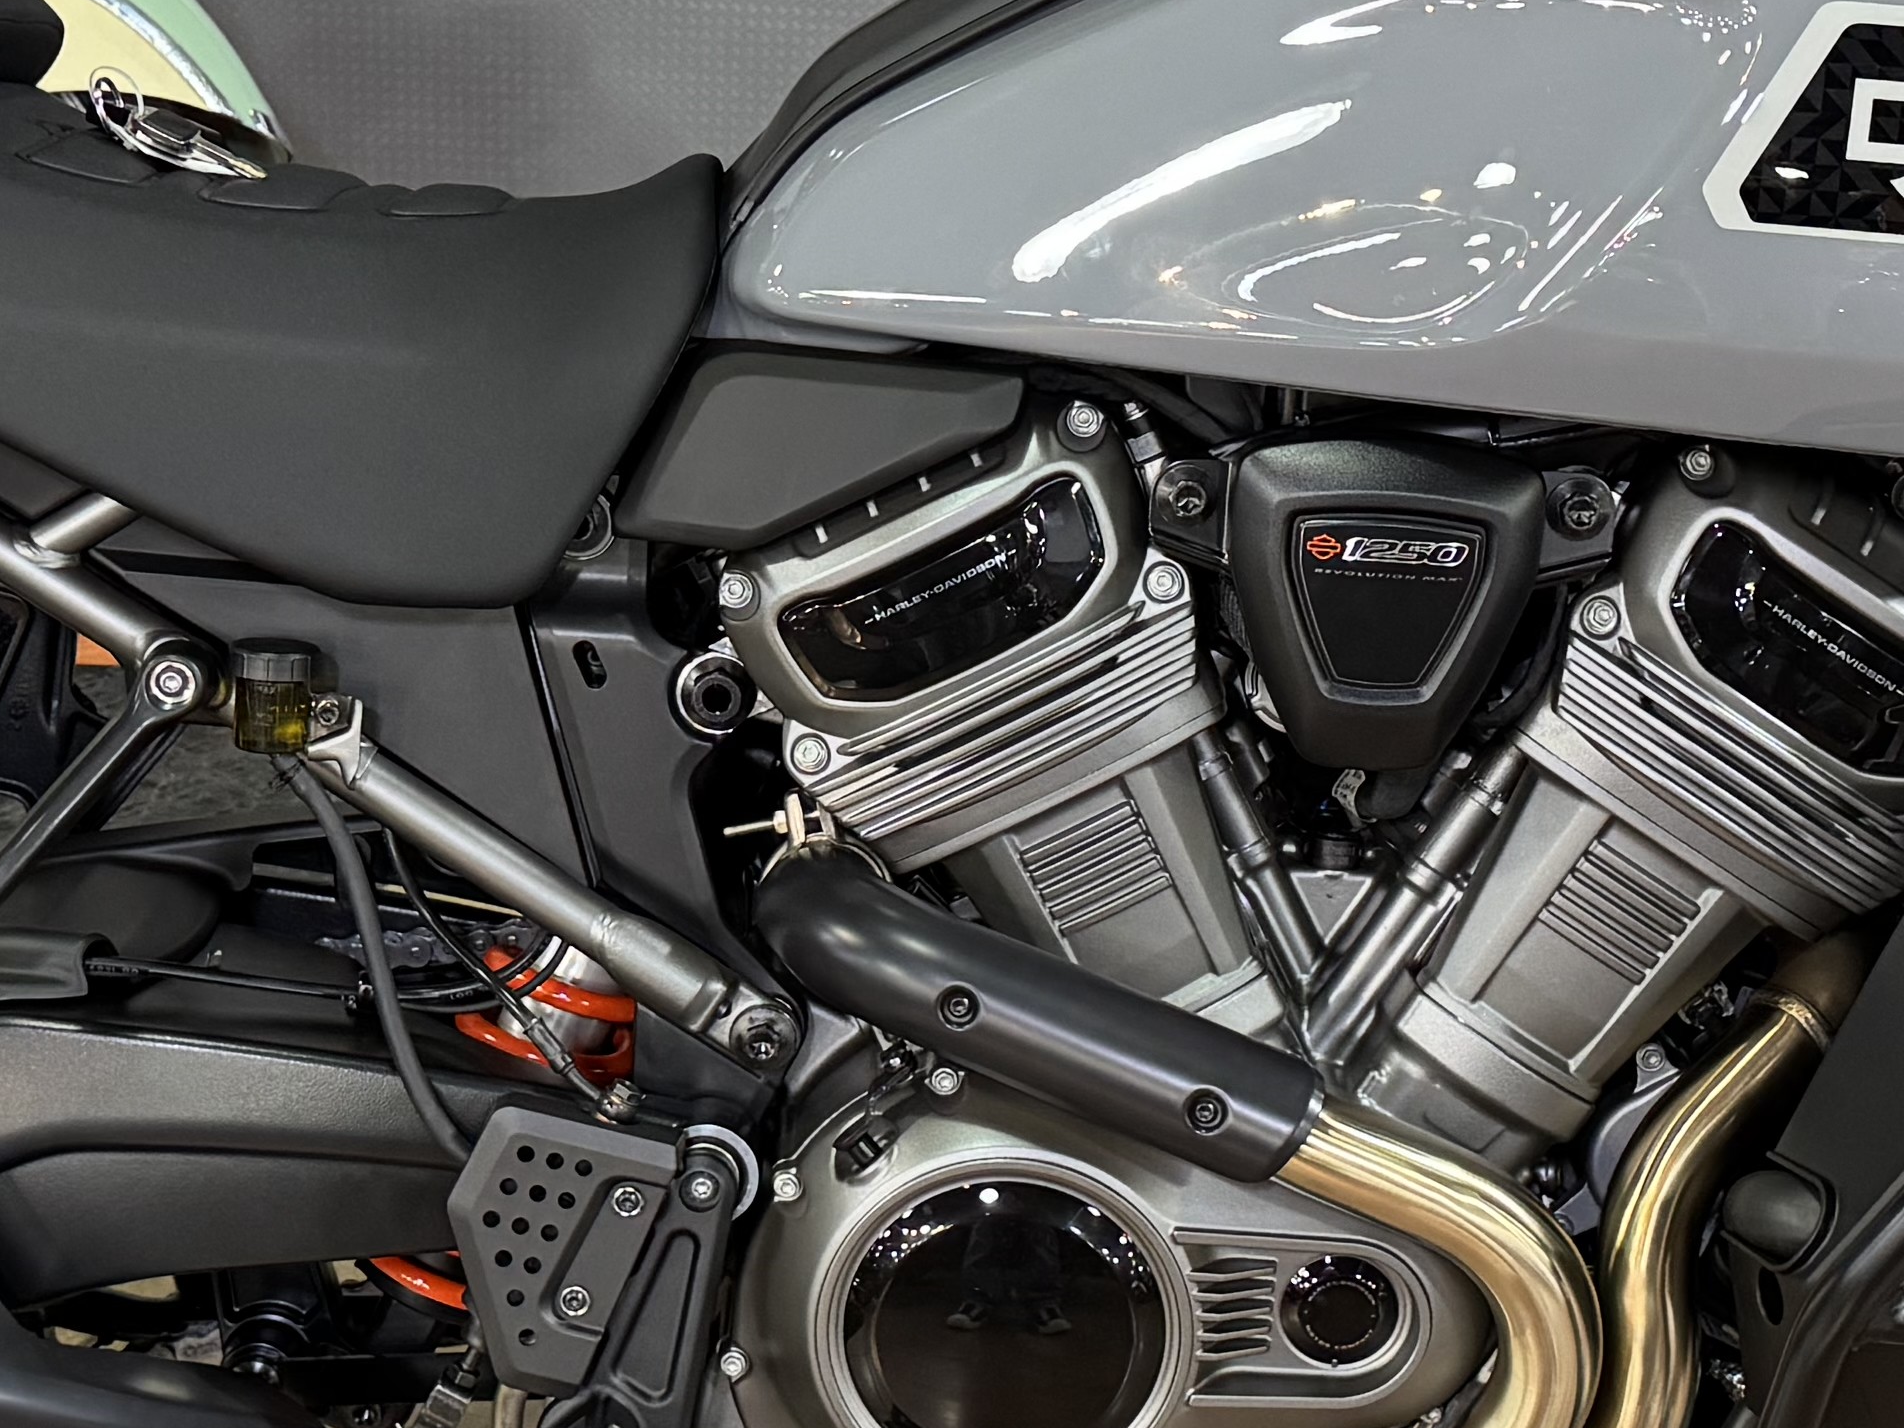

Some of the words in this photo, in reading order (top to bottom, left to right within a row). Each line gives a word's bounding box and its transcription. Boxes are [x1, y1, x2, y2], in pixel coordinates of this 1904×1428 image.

[1342, 536, 1470, 568] 1250
[1313, 567, 1417, 581] REVOLUTION
[1771, 603, 1898, 693] HARLEY-DAVIDSON
